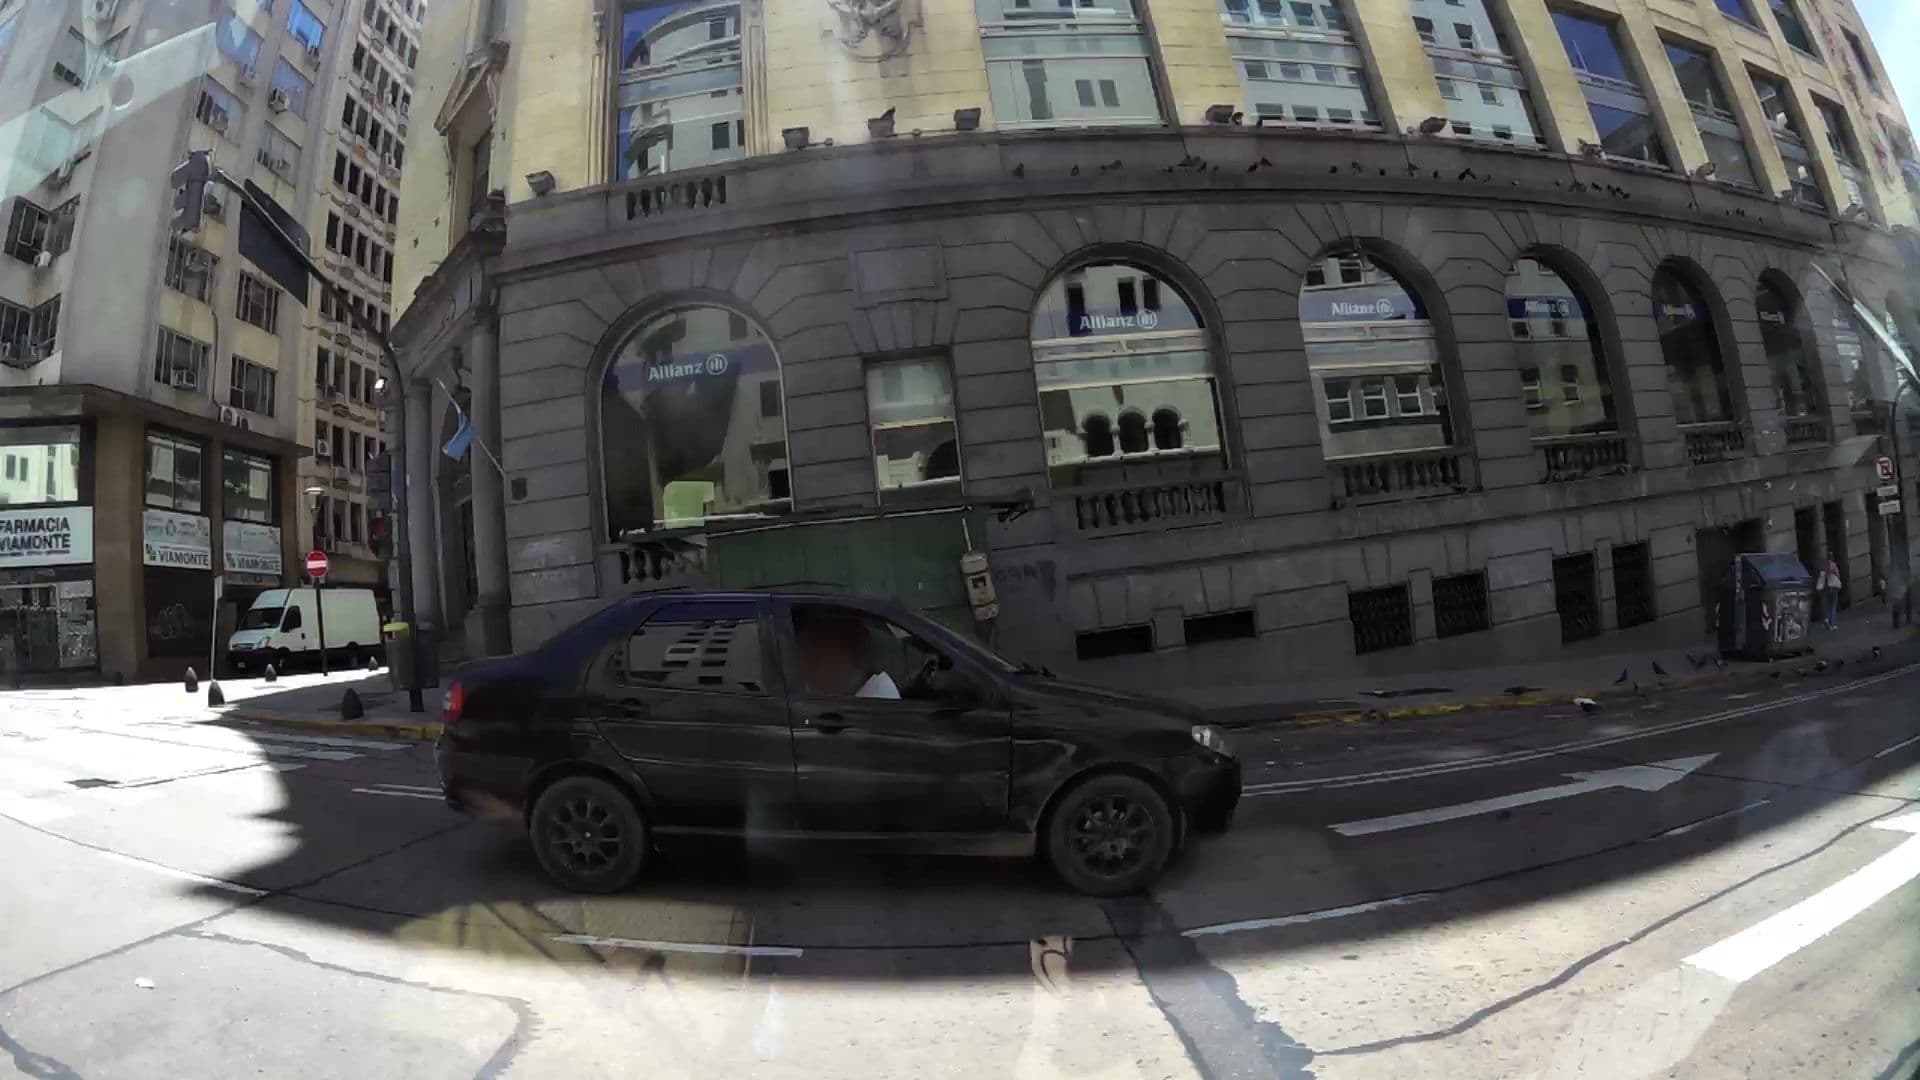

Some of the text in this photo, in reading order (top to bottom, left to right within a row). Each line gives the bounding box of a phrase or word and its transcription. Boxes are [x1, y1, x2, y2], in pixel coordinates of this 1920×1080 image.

[1080, 313, 1137, 329] Allianz
[648, 362, 703, 381] Allianz
[0, 517, 70, 534] FARMACIA
[0, 533, 71, 551] VIAMONTE
[159, 550, 209, 567] VIAMONTE
